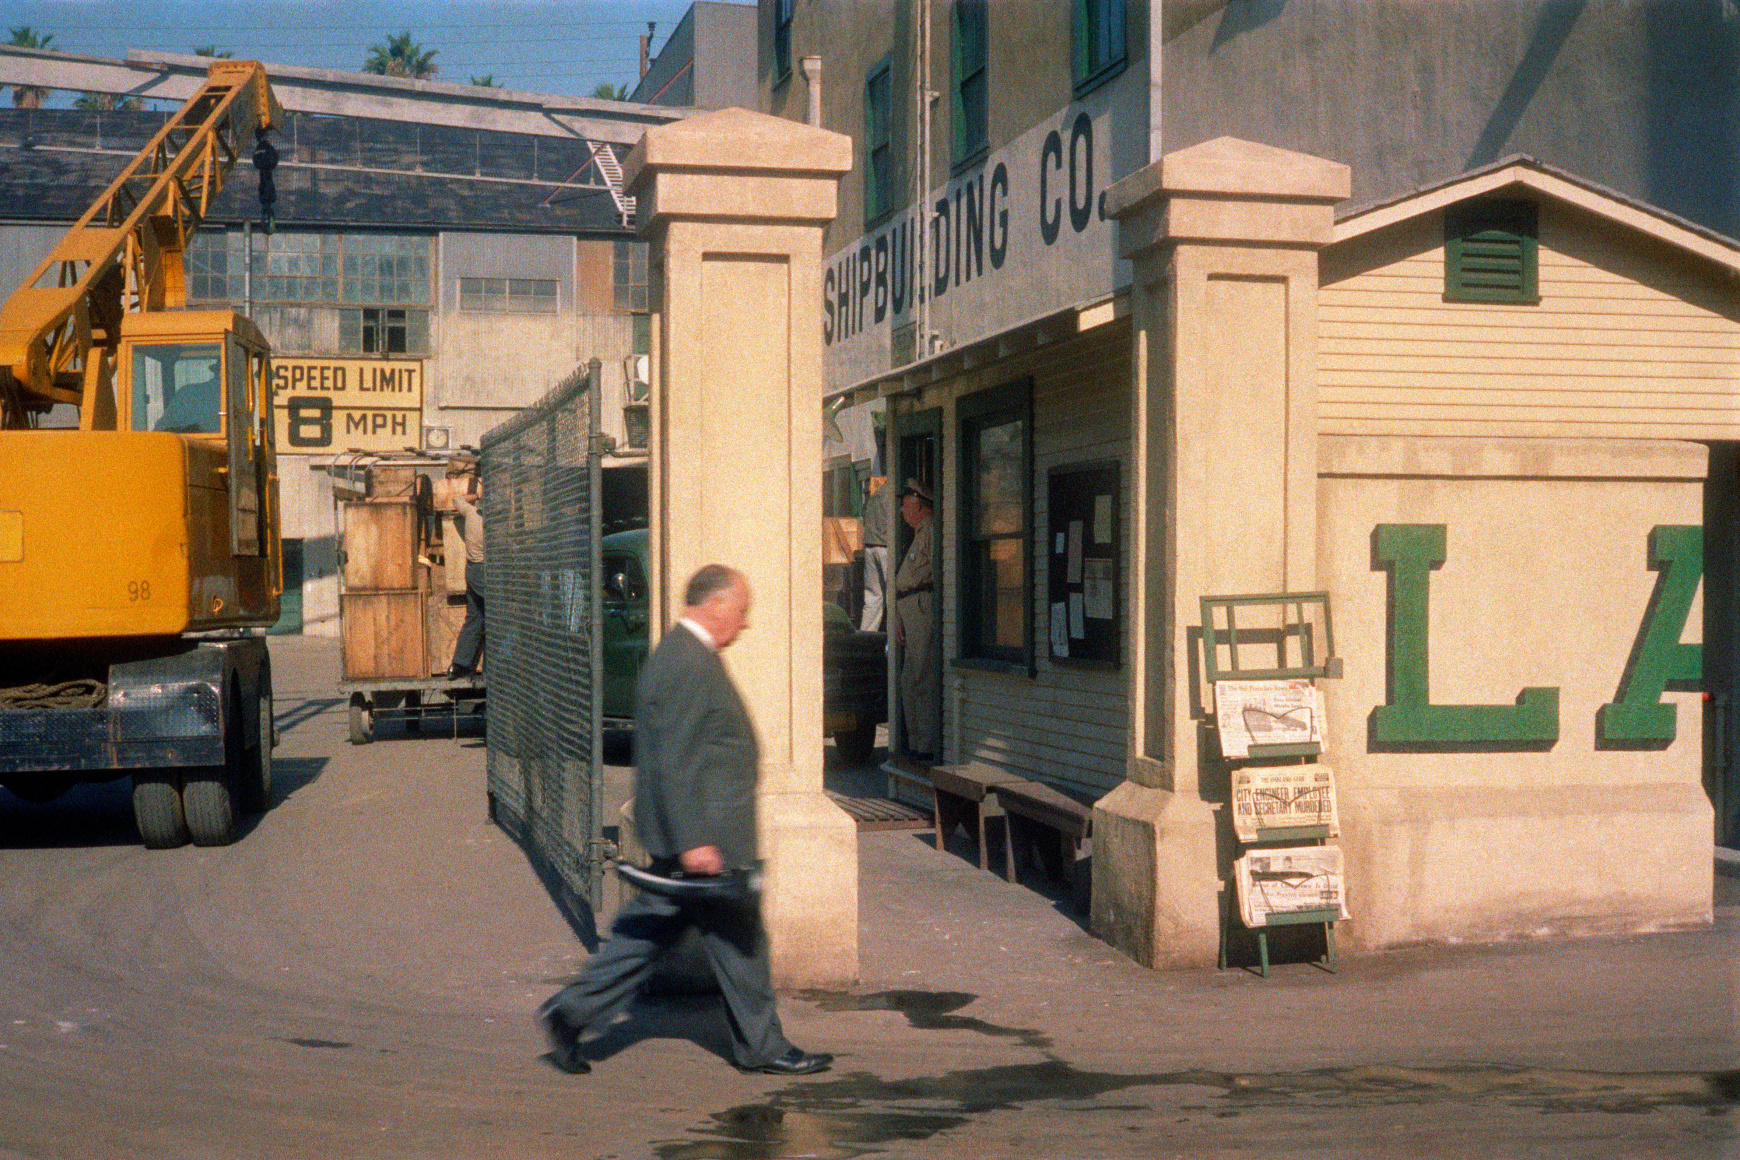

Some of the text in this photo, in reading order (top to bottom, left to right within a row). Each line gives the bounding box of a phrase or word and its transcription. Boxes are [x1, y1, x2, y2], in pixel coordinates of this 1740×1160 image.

[1040, 111, 1106, 246] CO.
[275, 365, 416, 393] SPEED LIMIT
[288, 396, 406, 447] 8 MPH
[128, 580, 151, 602] 98
[1236, 788, 1251, 802] CITY
[1255, 787, 1289, 801] ENGINEER
[1238, 802, 1252, 816] AND
